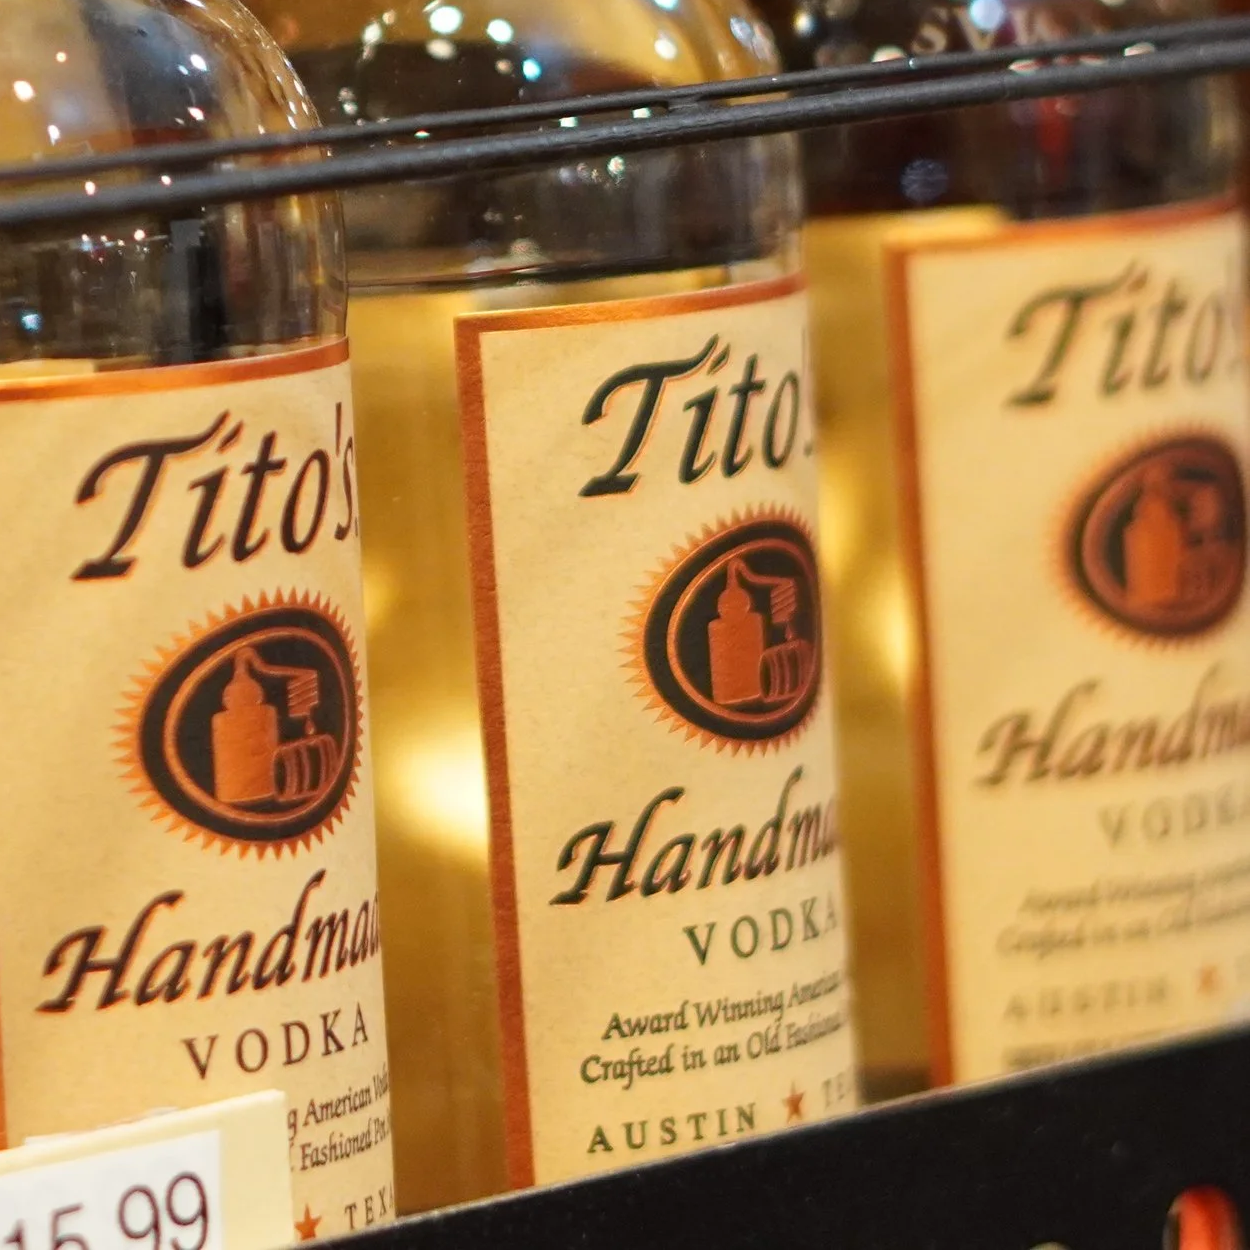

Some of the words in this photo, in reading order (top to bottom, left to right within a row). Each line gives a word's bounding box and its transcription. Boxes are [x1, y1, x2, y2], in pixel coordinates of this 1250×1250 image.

[69, 401, 354, 582] Tito's
[181, 1002, 370, 1080] VODKA
[600, 999, 689, 1041] Award
[693, 987, 785, 1027] Winning
[579, 1042, 675, 1091] Crafted
[681, 1046, 707, 1072] in
[713, 1039, 741, 1067] an
[746, 1020, 782, 1060] Old
[302, 1086, 371, 1128] American
[586, 1102, 758, 1154] AUSTIN
[300, 1117, 372, 1171] Fashioned
